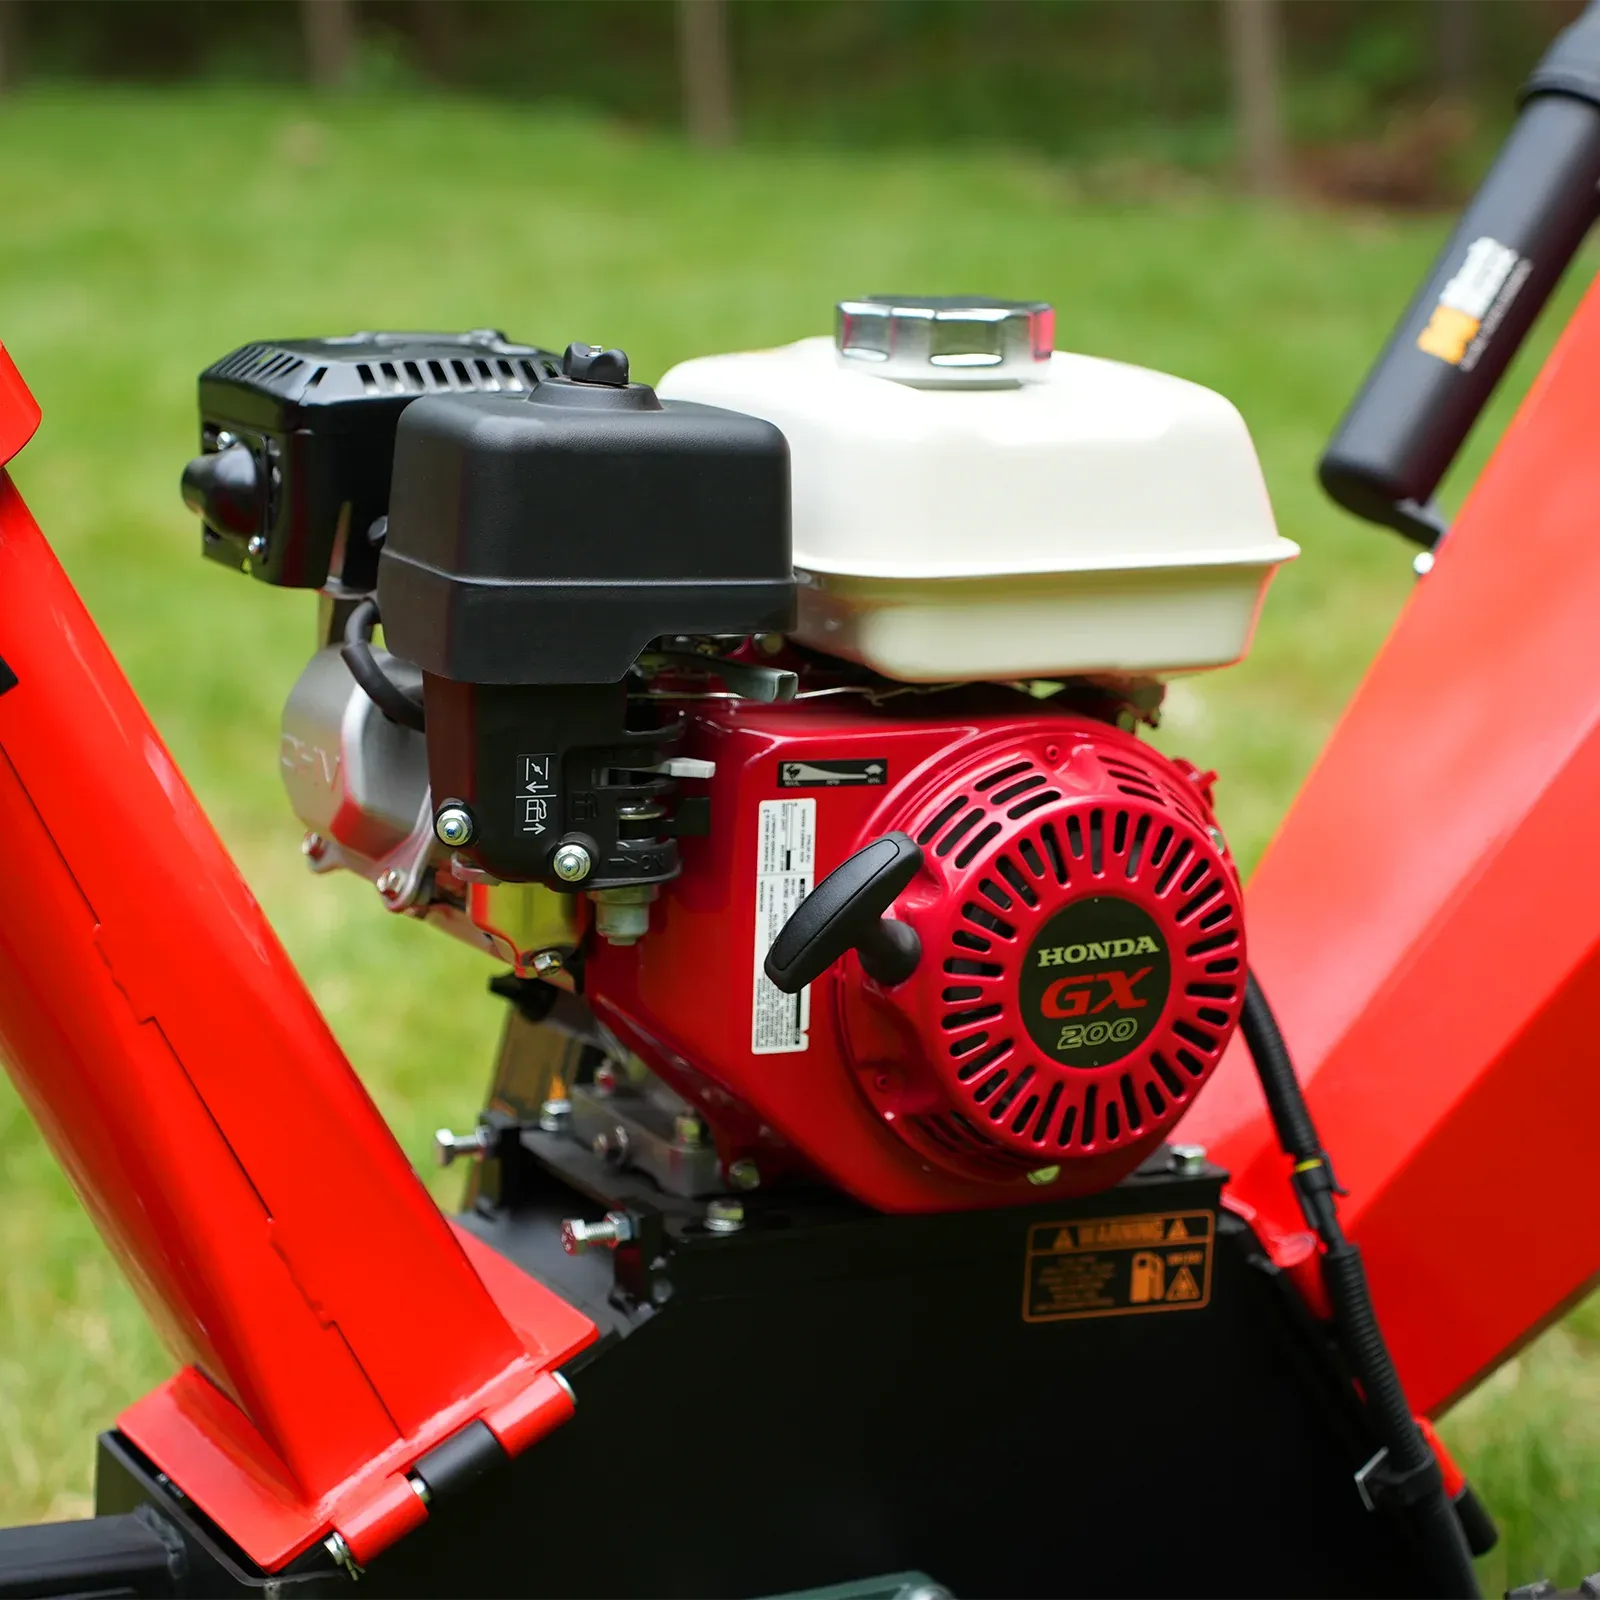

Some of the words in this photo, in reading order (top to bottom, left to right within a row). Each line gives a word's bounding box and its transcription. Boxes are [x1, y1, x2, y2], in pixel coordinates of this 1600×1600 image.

[1037, 935, 1160, 967] HONDA
[1040, 966, 1153, 1019] GX
[1056, 1017, 1138, 1050] 200
